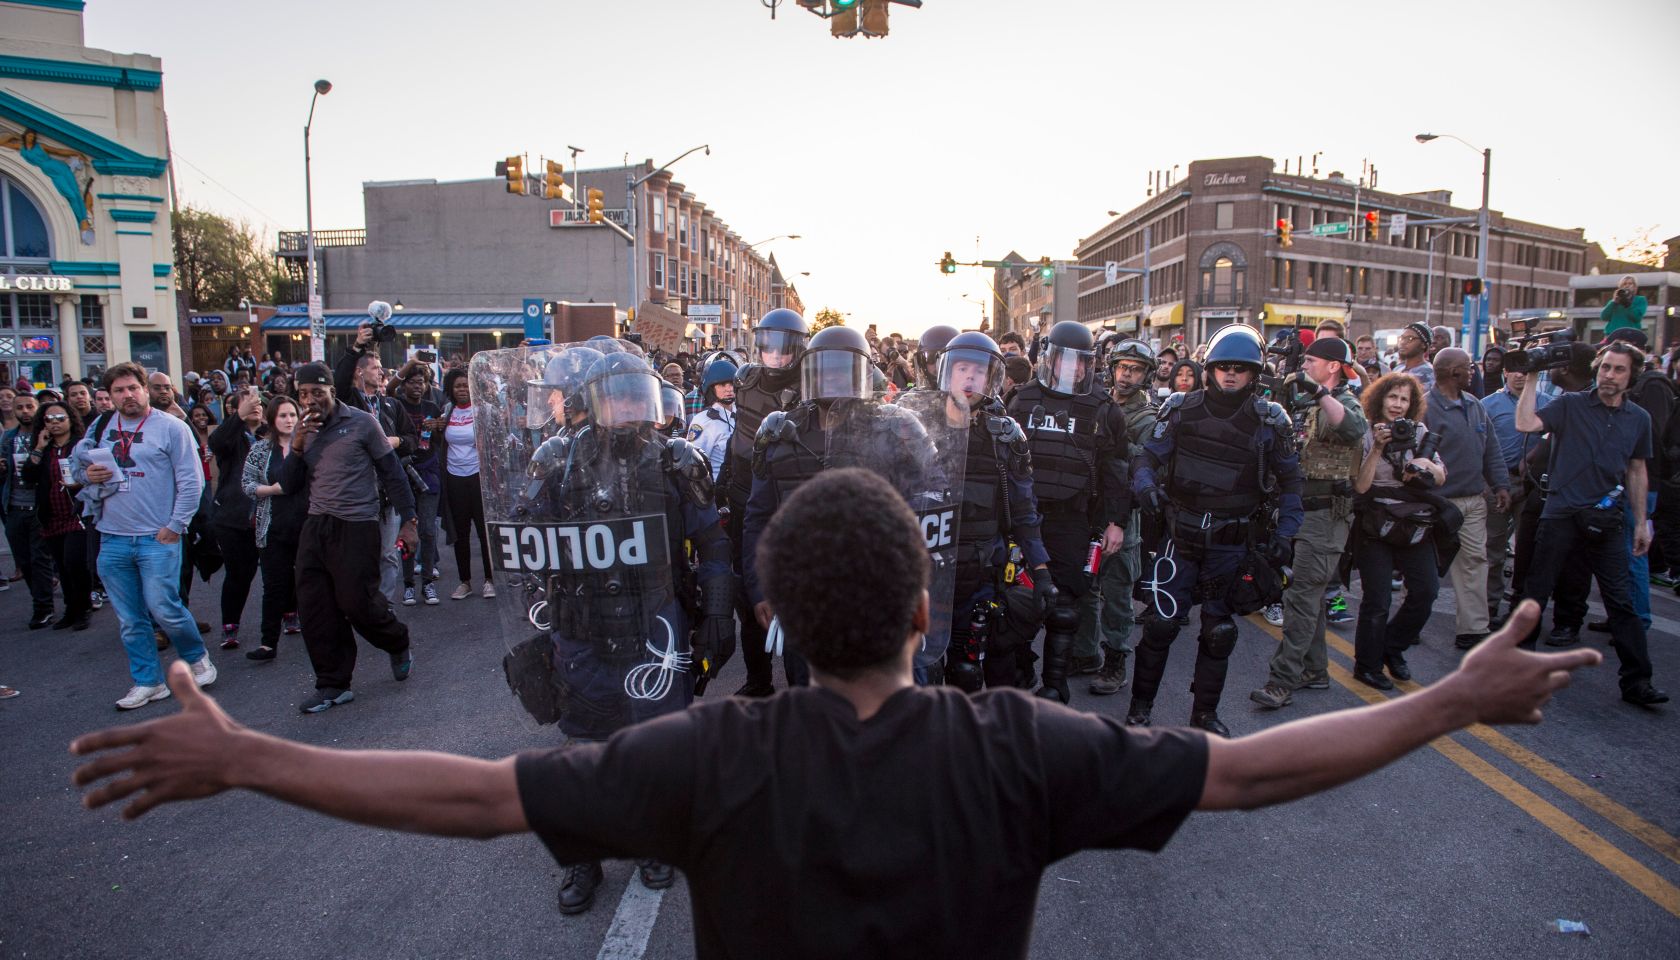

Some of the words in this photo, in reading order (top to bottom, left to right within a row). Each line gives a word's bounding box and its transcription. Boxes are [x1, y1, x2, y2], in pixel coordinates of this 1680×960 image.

[15, 276, 71, 291] CLUB
[499, 520, 648, 571] POLICE
[914, 510, 954, 549] CE
